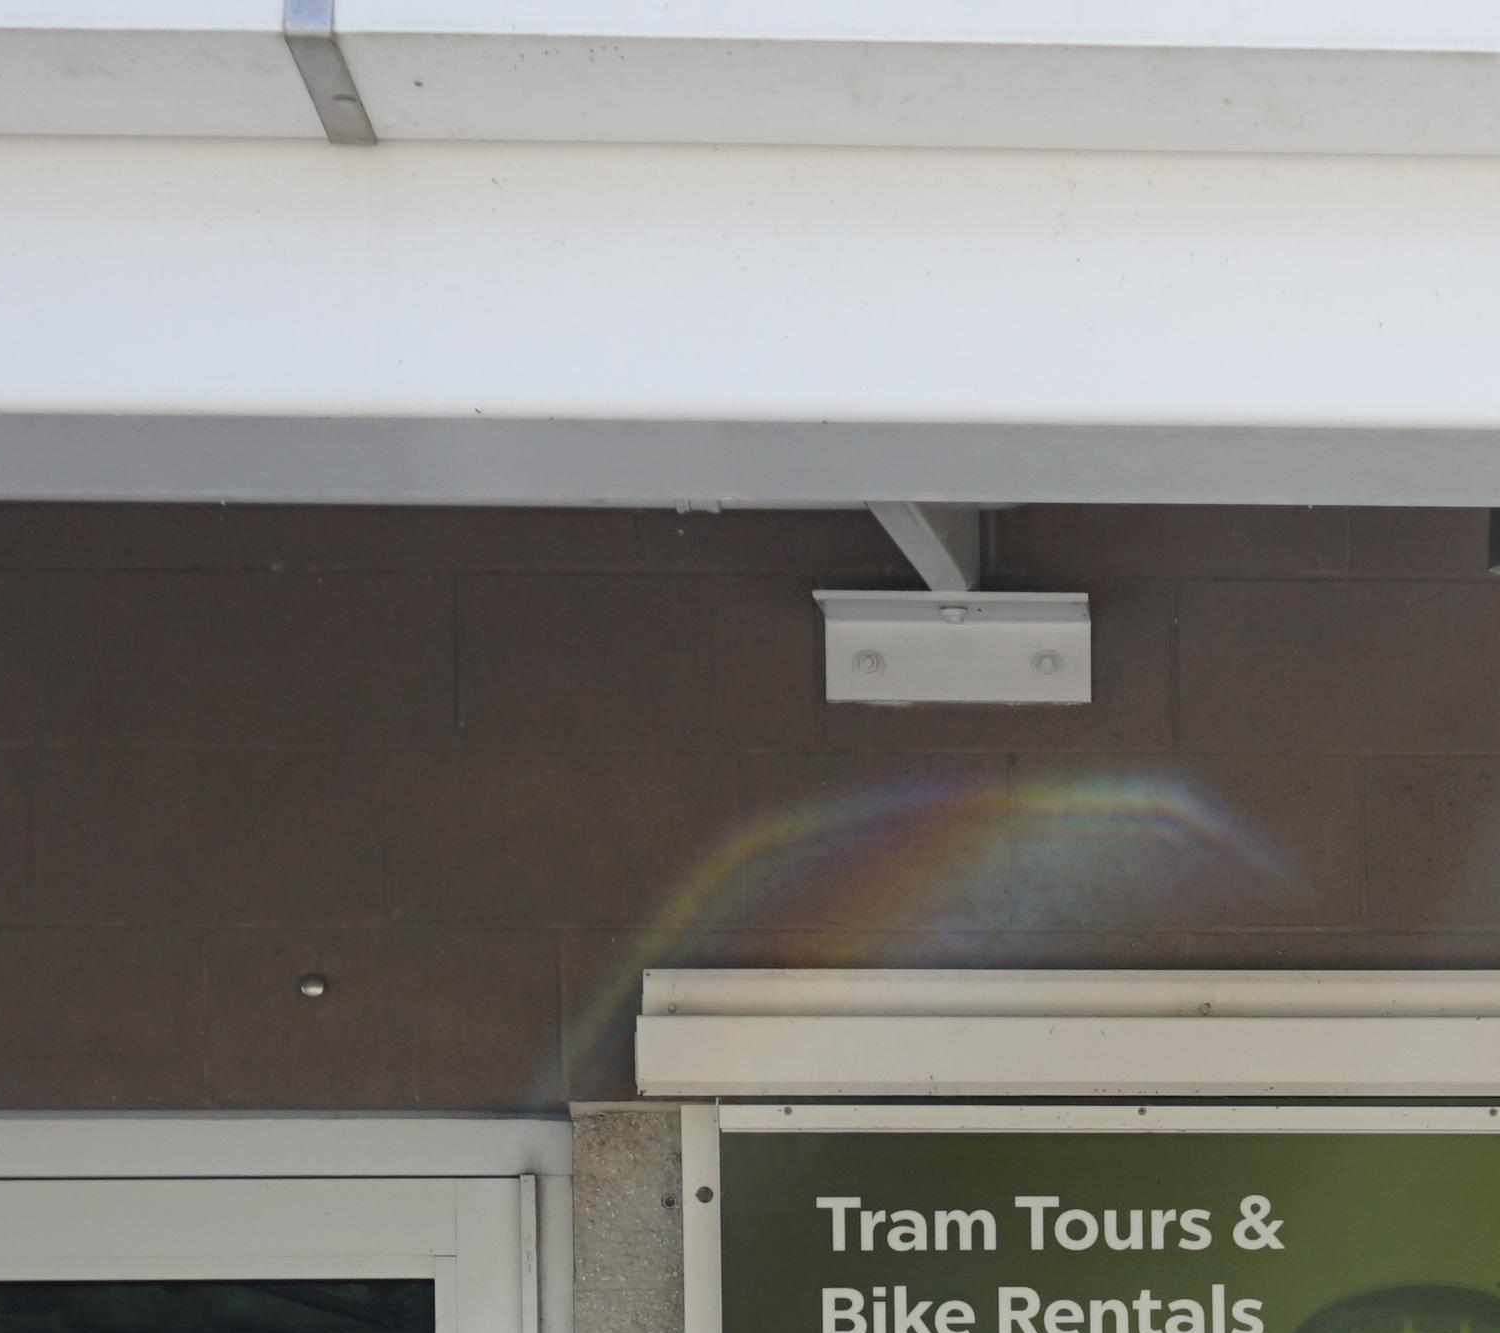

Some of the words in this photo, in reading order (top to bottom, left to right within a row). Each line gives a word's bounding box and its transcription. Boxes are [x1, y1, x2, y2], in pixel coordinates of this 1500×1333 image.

[816, 1197, 996, 1251] Tram
[1015, 1196, 1212, 1250] Tours
[1233, 1195, 1285, 1250] &
